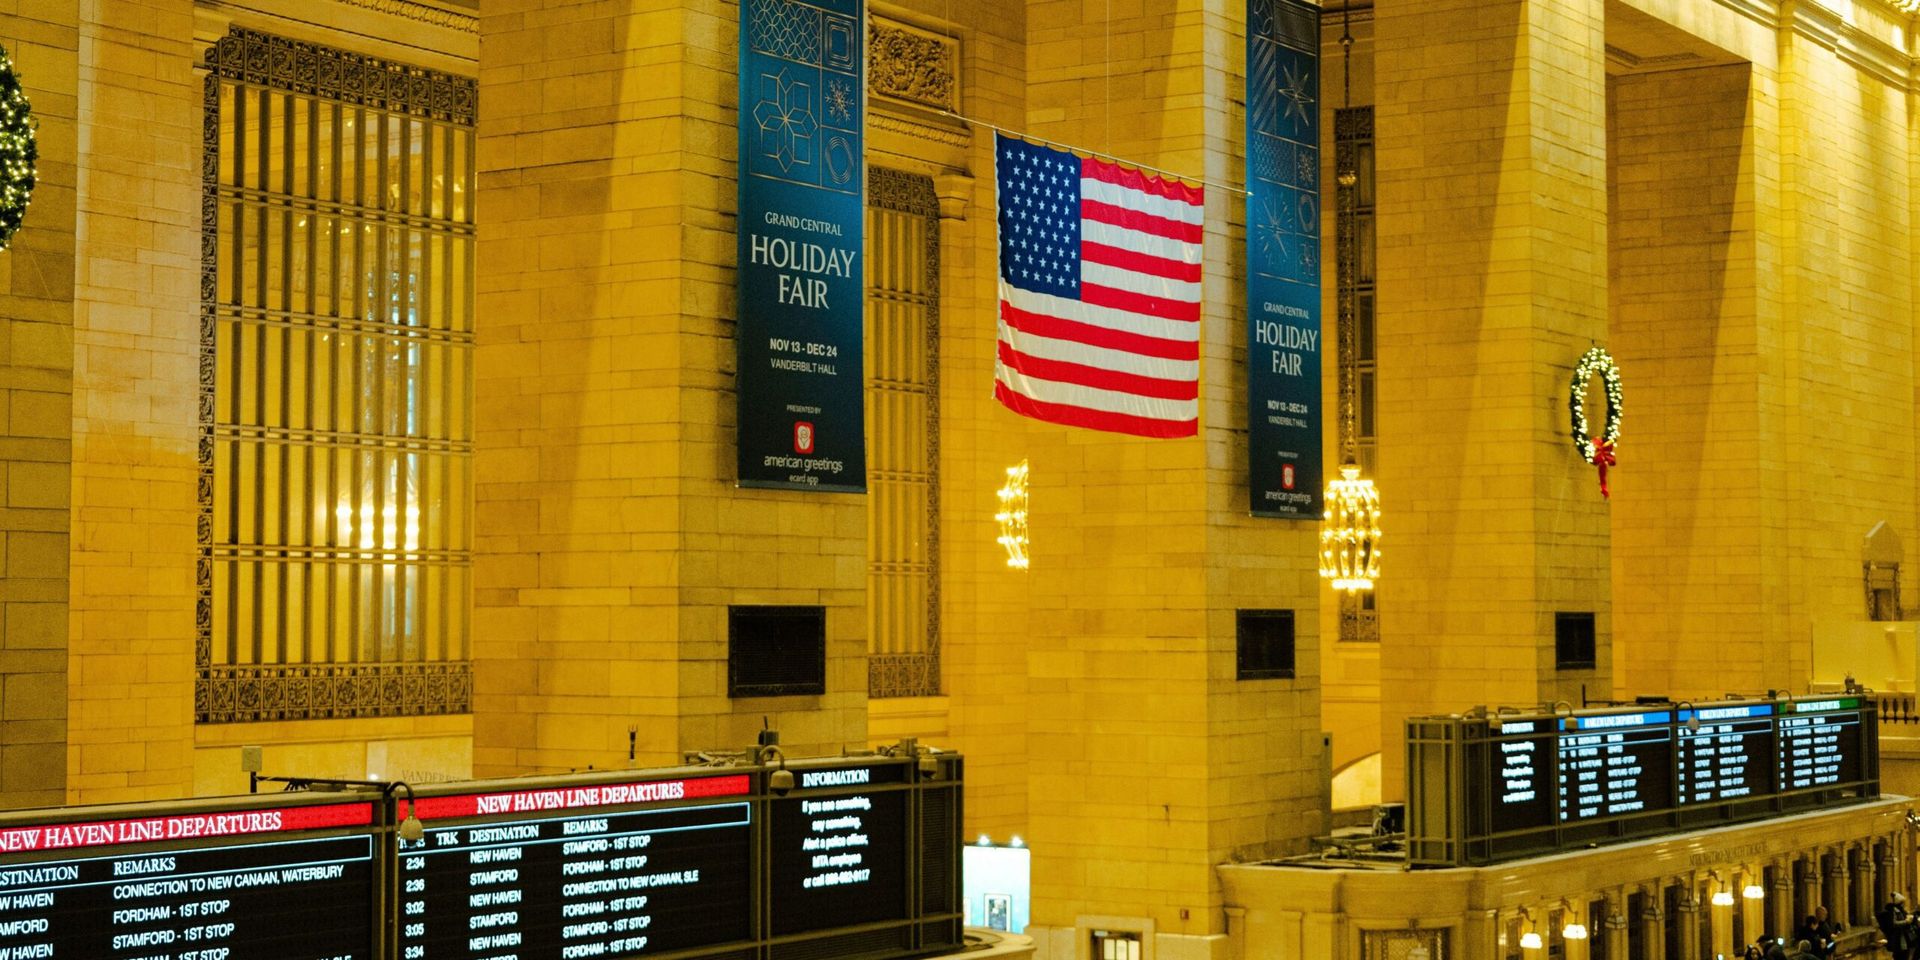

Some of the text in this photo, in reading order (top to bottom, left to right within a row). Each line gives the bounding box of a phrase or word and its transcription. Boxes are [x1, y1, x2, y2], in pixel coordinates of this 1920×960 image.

[765, 211, 843, 236] GRAND CENTRAL
[751, 233, 856, 278] HOLIDAY
[778, 274, 830, 309] FAIR
[1263, 301, 1310, 319] GRAND CENTRAL
[1256, 319, 1318, 352] HOLIDAY
[769, 338, 790, 351] NOV
[791, 341, 800, 353] 13
[807, 343, 825, 356] DEC
[826, 345, 838, 357] 24
[770, 358, 837, 375] VANDERBILT HALL
[1272, 350, 1302, 377] FAIR
[764, 454, 843, 474] american greetings
[789, 473, 819, 486] ecard app
[803, 769, 869, 787] INFORMATION
[477, 782, 684, 814] NEW HAVEN LINE DEPARTURES
[0, 811, 282, 850] NEW HAVEN LINE DEPARTURES
[469, 825, 539, 844] DESTINATION
[563, 819, 608, 835] REMARKS
[436, 831, 458, 846] TRK
[563, 839, 608, 855] STAMFORD
[613, 837, 628, 850] 1ST
[629, 835, 651, 848] STOP
[406, 857, 425, 870] 2:34
[470, 847, 522, 864] NEW HAVEN
[113, 857, 176, 876] REMARKS
[563, 860, 604, 876] FORDHAM
[610, 857, 625, 871] 1ST
[625, 855, 647, 869] STOP
[113, 864, 344, 900] CONNECTION TO NEW CANAAN, WATERBURY
[406, 879, 425, 892] 2:36
[470, 869, 518, 886] STAMFORD
[563, 869, 699, 896] CONNECTION TO NEW CANAAN, SLE
[13, 892, 54, 910] HAVEN
[405, 901, 424, 915] 3:02
[470, 890, 522, 907] NEW HAVEN
[563, 901, 604, 917] FORDHAM
[610, 898, 625, 912] 1ST
[625, 896, 647, 910] STOP
[113, 906, 170, 924] FORDHAM
[180, 902, 199, 918] 1ST
[201, 900, 230, 915] STOP
[470, 911, 518, 929] STAMFORD
[113, 929, 175, 949] STAMFORD
[184, 926, 203, 941] 1ST
[206, 923, 235, 938] STOP
[405, 923, 424, 937] 3:05
[563, 921, 608, 939] STAMFORD
[613, 918, 628, 932] 1ST
[629, 915, 651, 929] STOP
[470, 932, 522, 950] NEW HAVEN
[563, 941, 604, 959] FORDHAM
[610, 939, 625, 952] 1ST
[625, 936, 647, 950] STOP
[12, 943, 53, 960] HAVEN
[405, 945, 424, 959] 3:34
